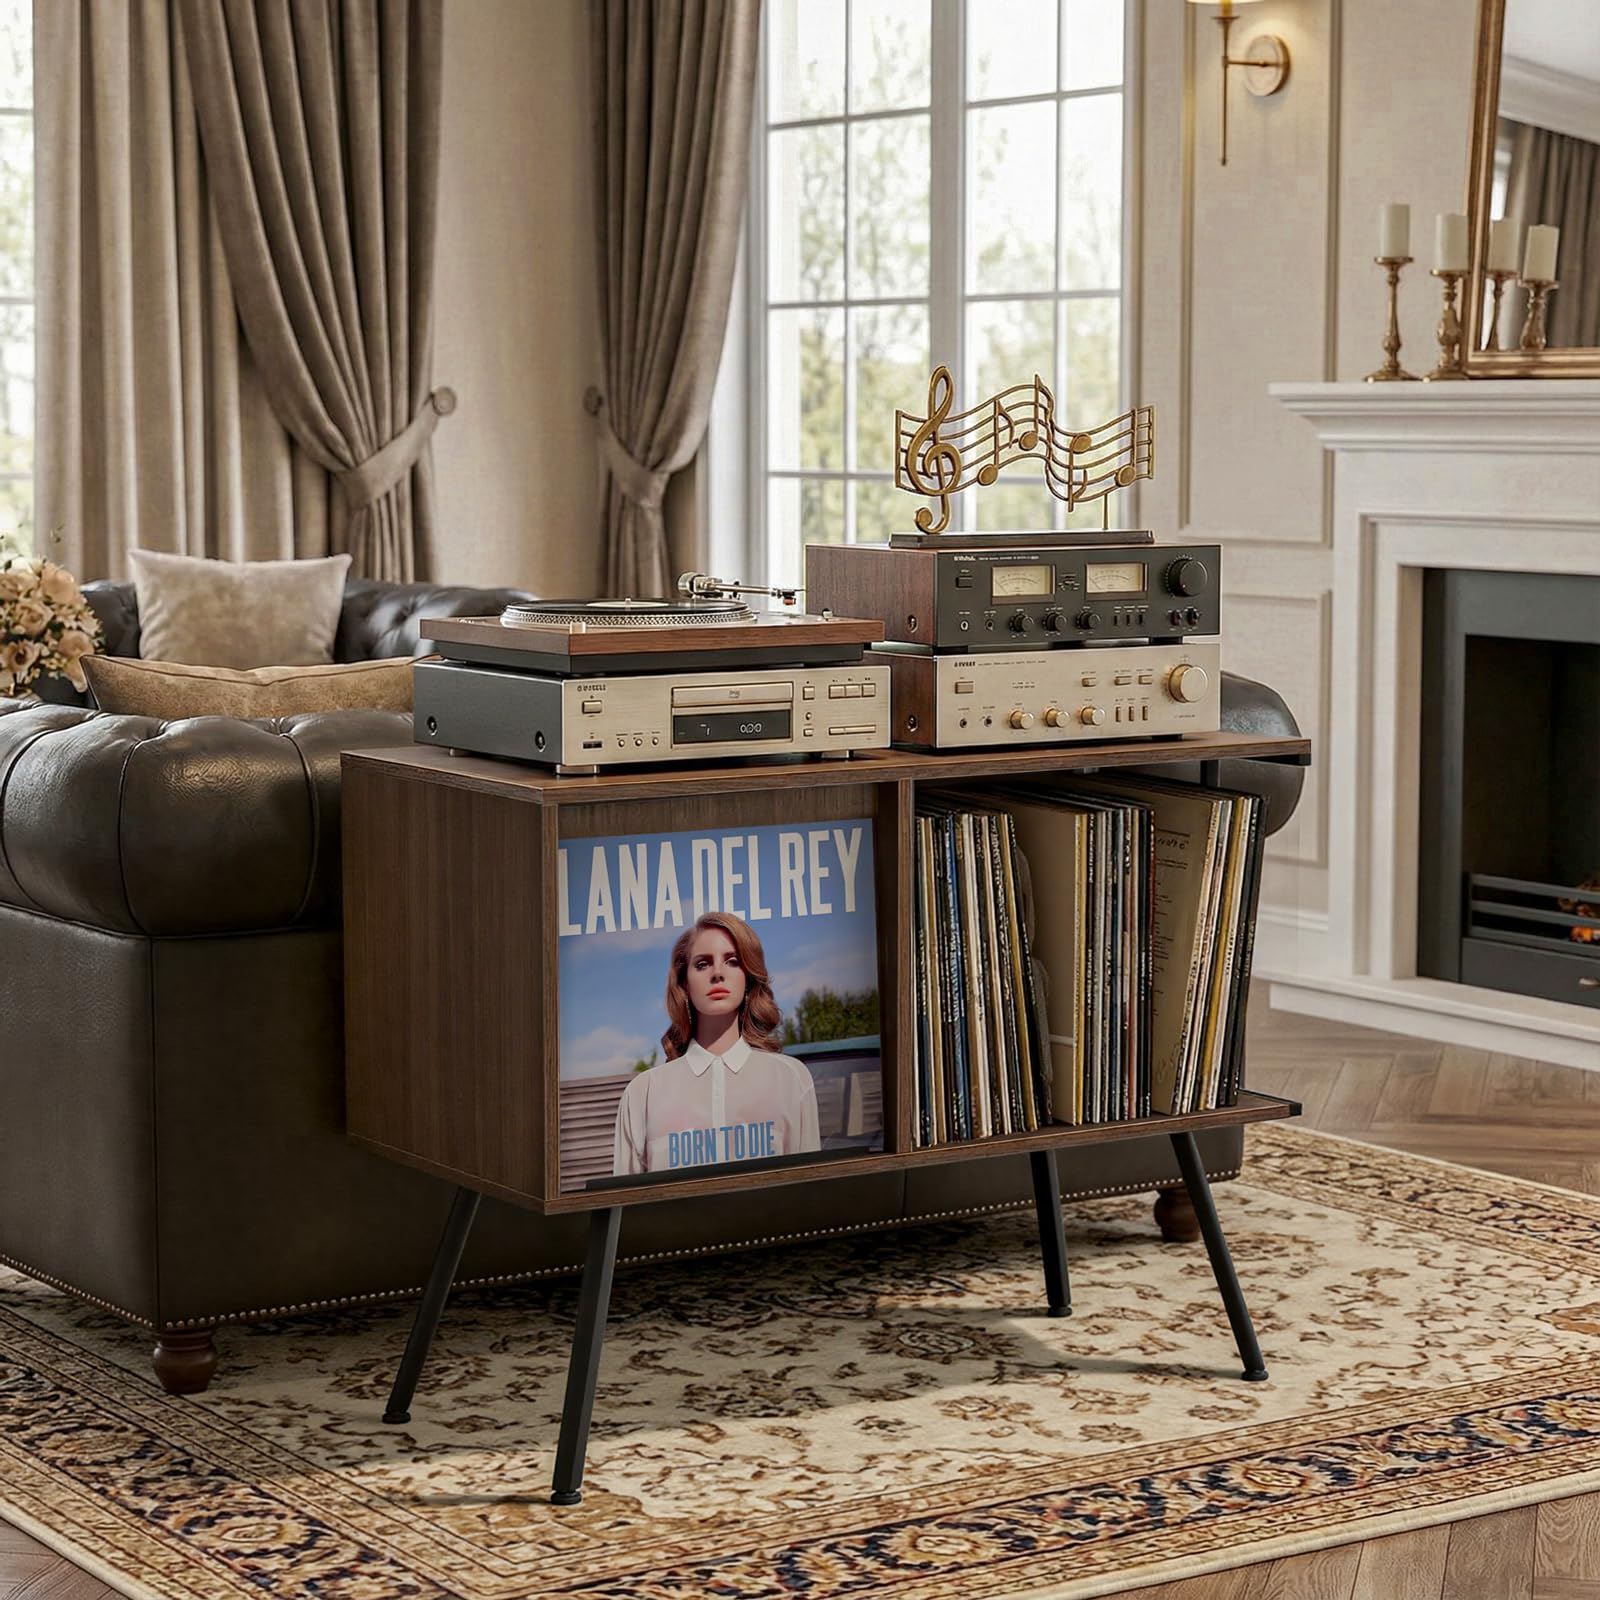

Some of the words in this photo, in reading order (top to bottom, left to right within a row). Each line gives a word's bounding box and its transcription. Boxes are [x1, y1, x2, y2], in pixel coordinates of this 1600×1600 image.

[559, 841, 684, 936] LANA
[692, 835, 772, 922] DEL
[779, 828, 862, 918] REY
[668, 1128, 717, 1168] BORN
[719, 1124, 745, 1160] TO
[748, 1120, 776, 1157] DIE
